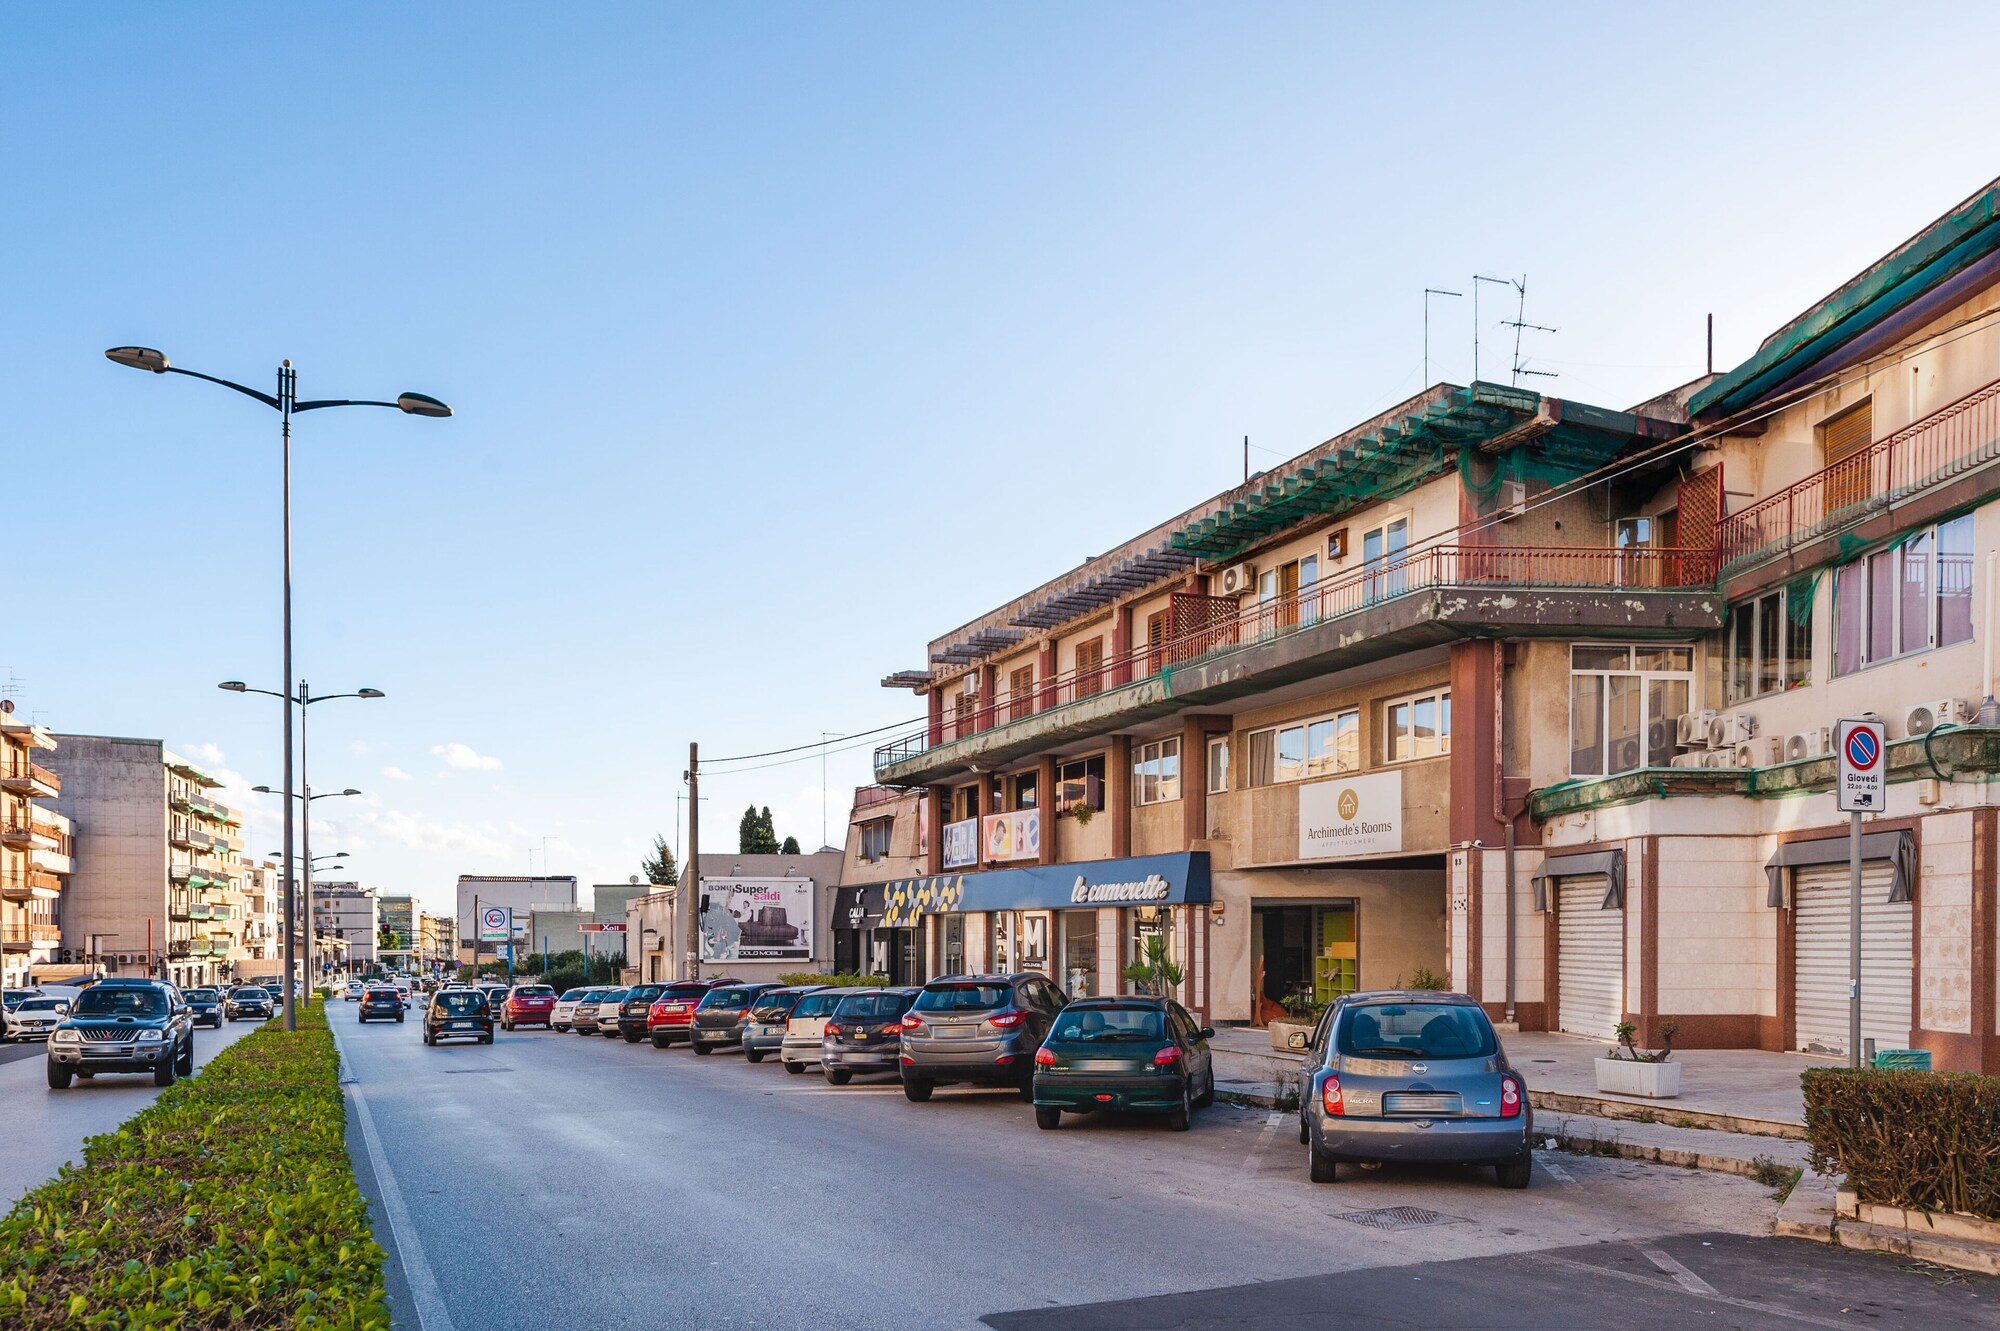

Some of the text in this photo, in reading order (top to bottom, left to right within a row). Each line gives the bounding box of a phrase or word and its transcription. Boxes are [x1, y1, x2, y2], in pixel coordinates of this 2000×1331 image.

[1866, 783, 1878, 791] 4.00
[1307, 821, 1392, 840] Archimede's Rooms
[1321, 837, 1376, 848] AFFITTACAMERE
[735, 884, 769, 896] Super
[1071, 874, 1169, 903] le camerette
[753, 891, 781, 901] saldi
[488, 914, 503, 923] Xoil
[849, 907, 864, 919] CALIA
